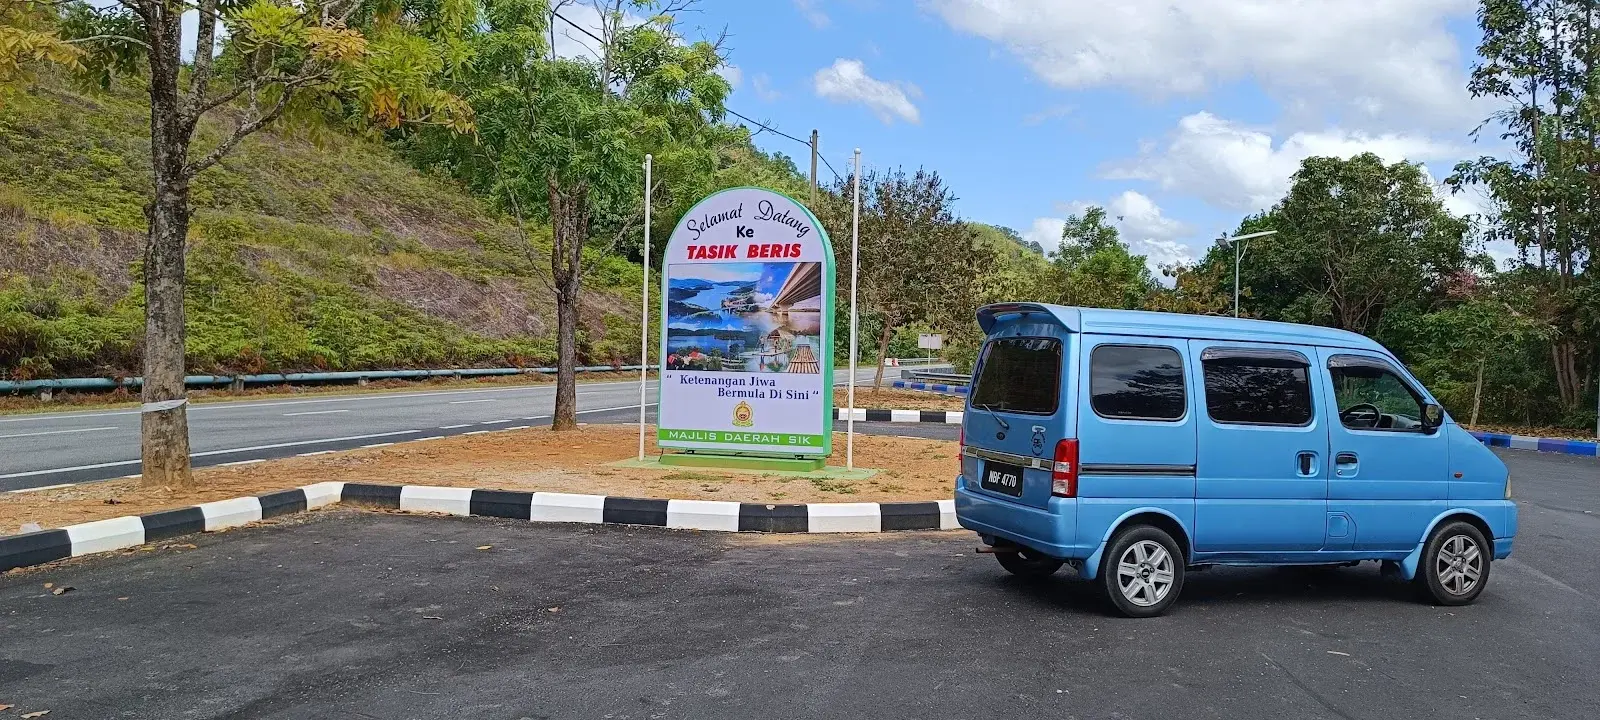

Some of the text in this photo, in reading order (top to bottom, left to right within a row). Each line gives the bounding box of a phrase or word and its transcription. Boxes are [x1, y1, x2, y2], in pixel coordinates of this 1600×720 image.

[686, 200, 811, 240] Selamat Datang
[736, 225, 754, 238] Ke
[687, 244, 801, 259] TASIK BERIS
[680, 374, 746, 387] Ketenangan
[749, 377, 776, 387] Jiwa
[718, 388, 765, 399] Bermula
[769, 389, 782, 400] Di
[786, 389, 809, 401] Sini
[669, 430, 812, 445] MAJLIS DAERAH SIK
[988, 470, 1017, 487] NBF 4770
